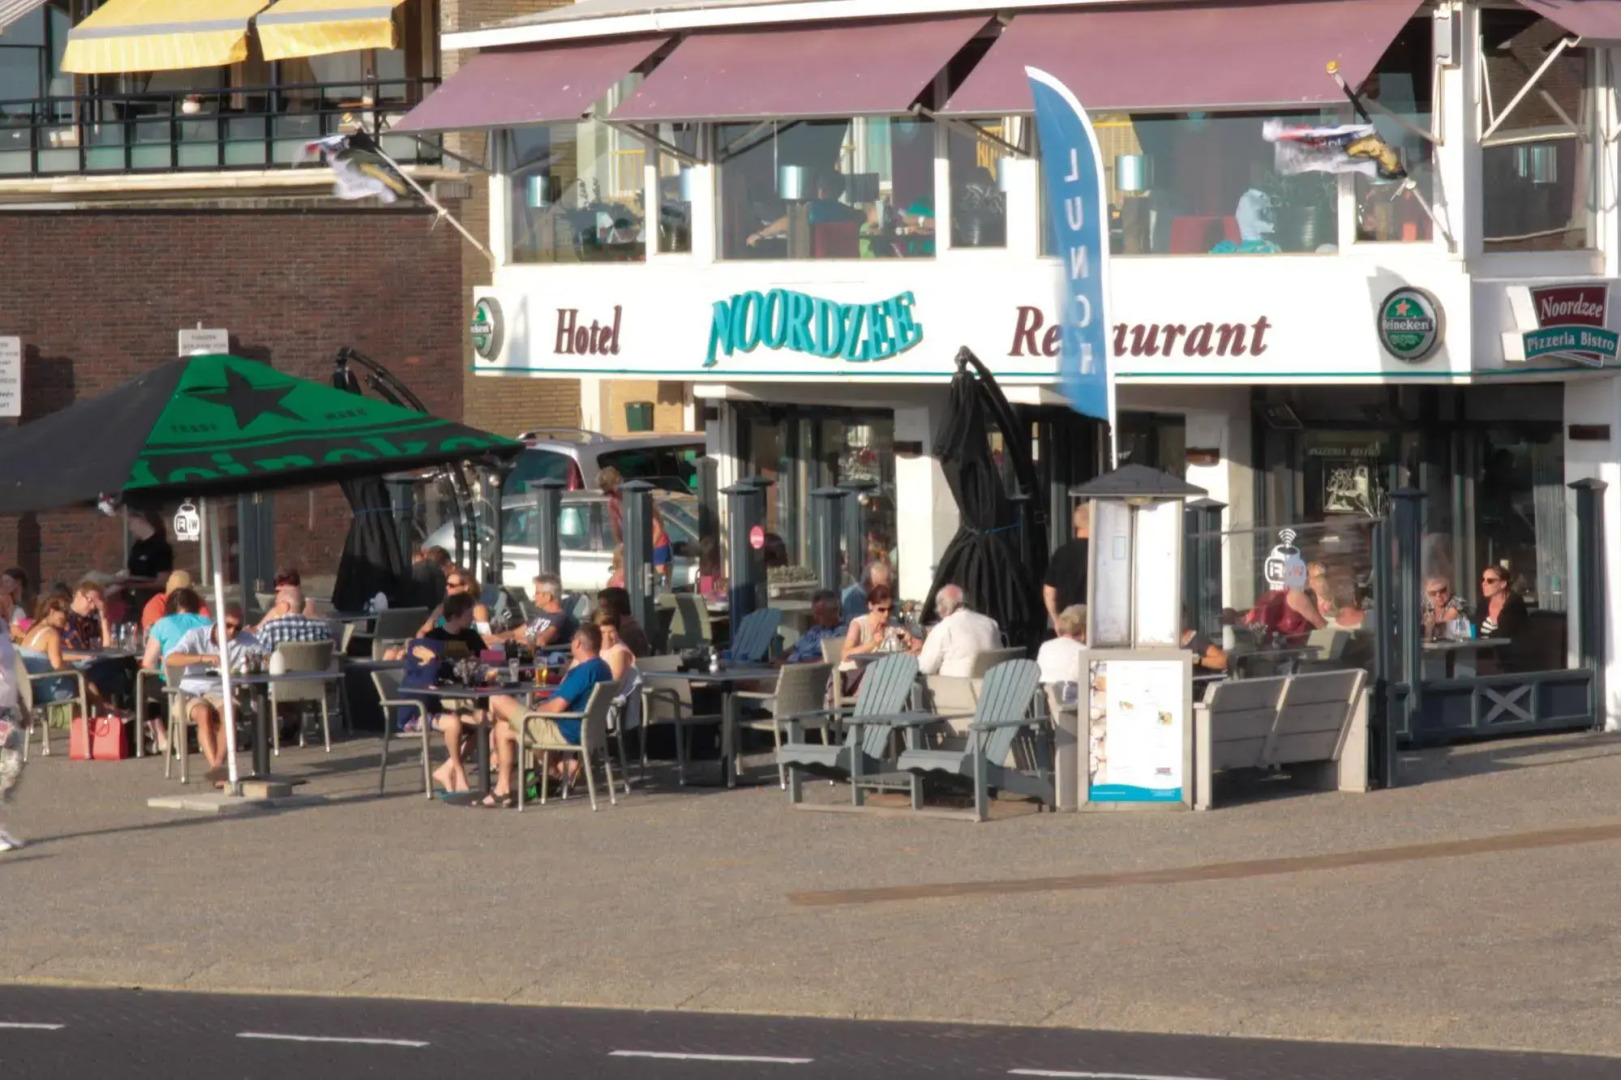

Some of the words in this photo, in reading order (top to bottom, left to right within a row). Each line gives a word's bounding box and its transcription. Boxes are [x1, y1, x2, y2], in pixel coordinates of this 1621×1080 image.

[1541, 292, 1603, 320] Noordzee
[553, 304, 622, 355] Hotel
[702, 288, 922, 367] NOORDZEE
[1007, 305, 1272, 357] Reaurant
[1383, 319, 1430, 331] eineken
[1527, 332, 1575, 352] Pizzeria
[1580, 331, 1615, 350] Bistro
